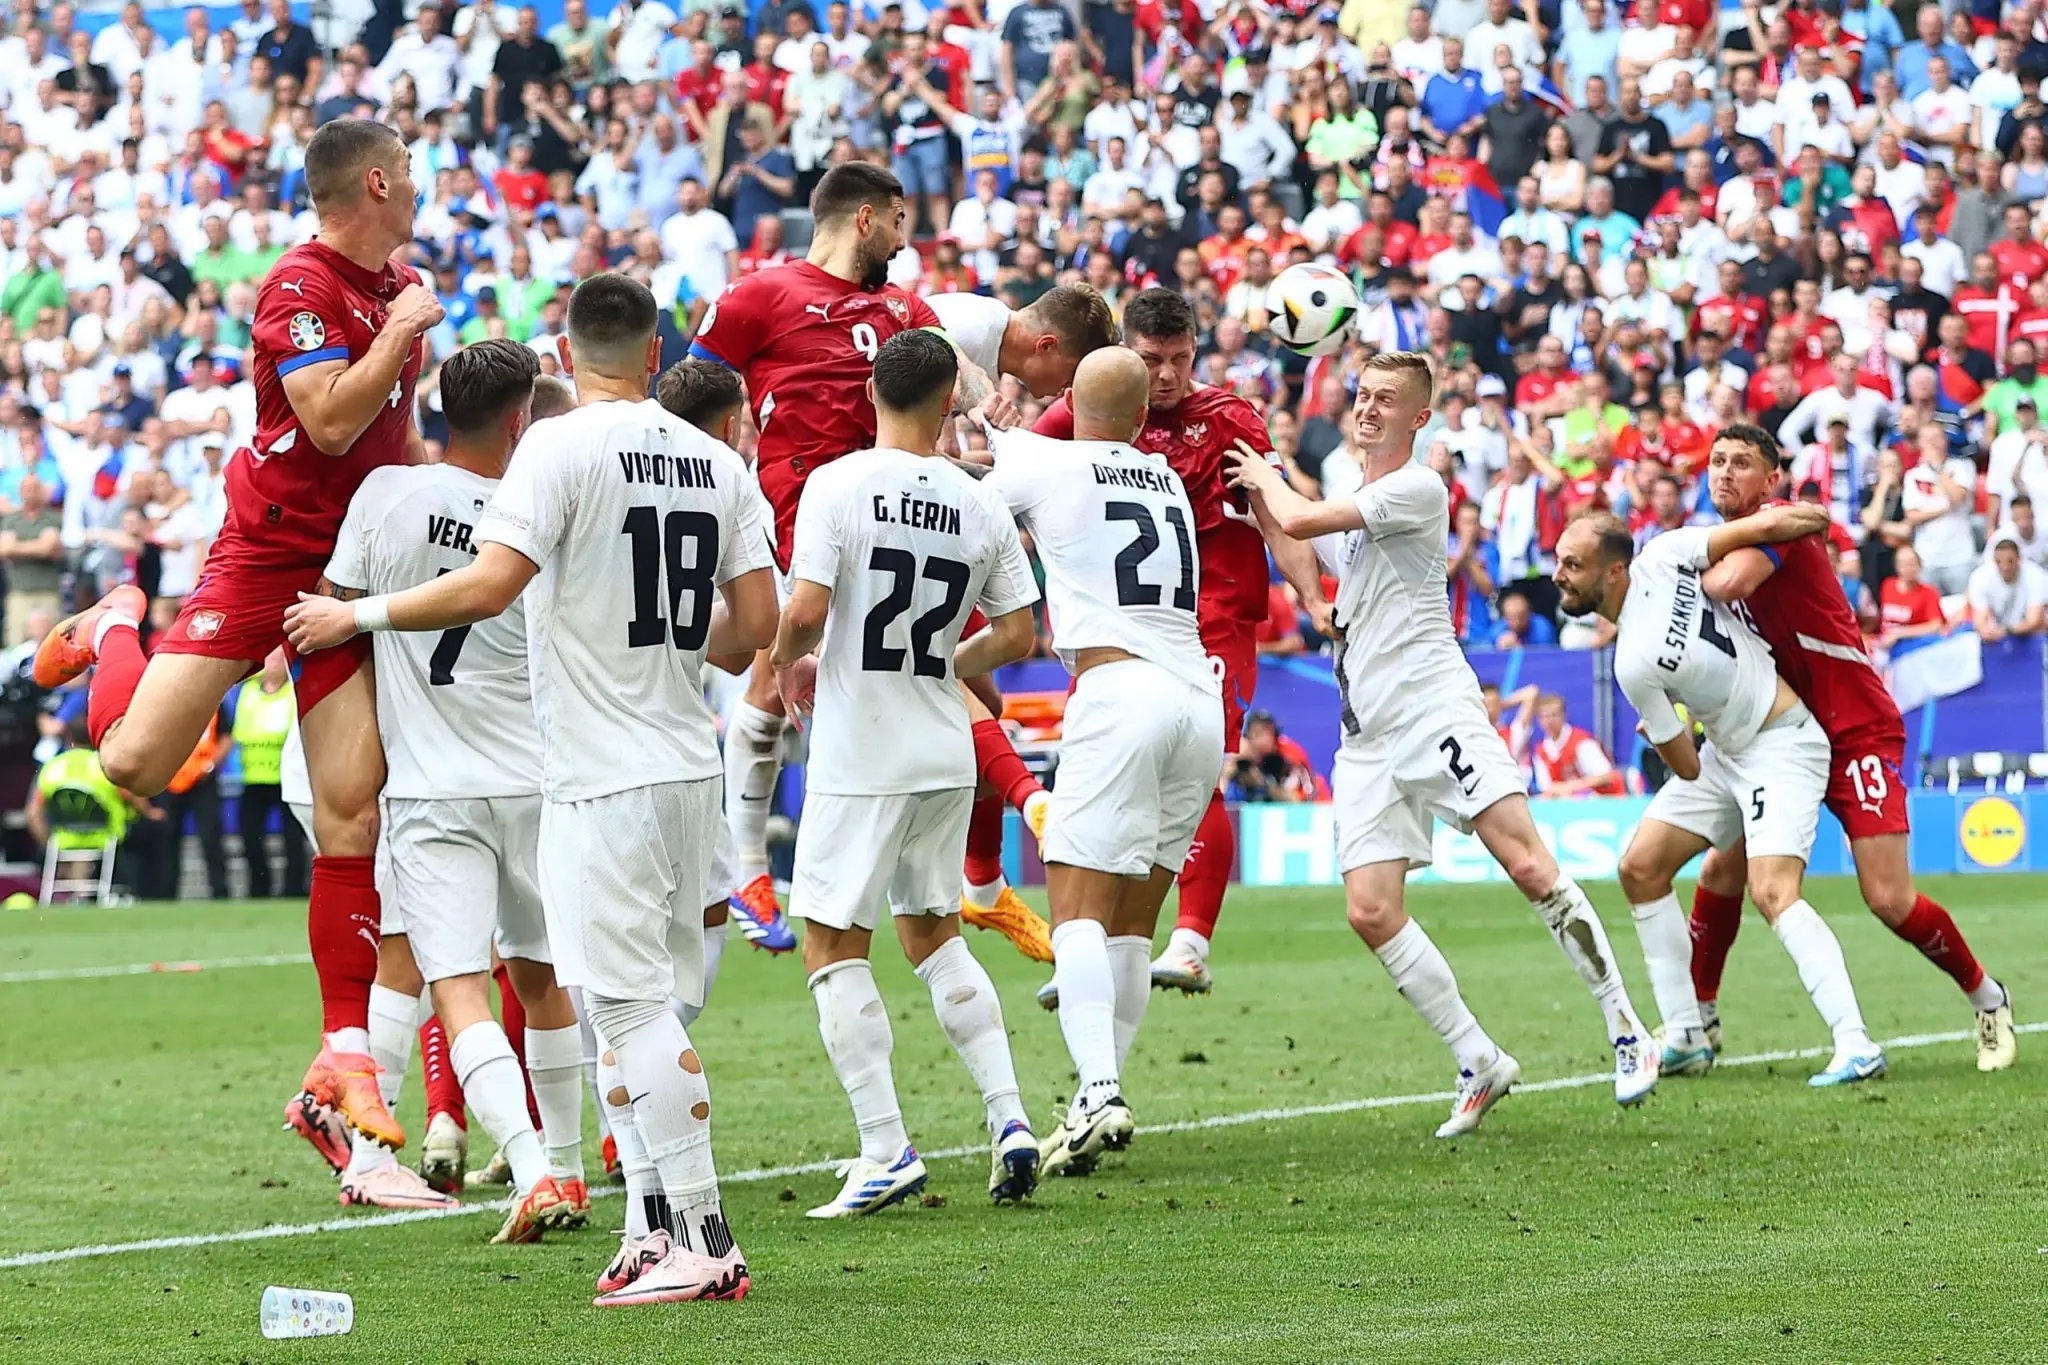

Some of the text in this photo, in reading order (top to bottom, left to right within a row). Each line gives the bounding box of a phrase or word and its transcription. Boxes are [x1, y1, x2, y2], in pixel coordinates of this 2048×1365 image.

[851, 322, 878, 362] 9
[428, 514, 480, 556] VER
[873, 491, 961, 536] G. ČERIN
[621, 505, 719, 651] 18
[1105, 501, 1196, 612] 21
[862, 546, 971, 680] 22
[1439, 735, 1475, 784] 2
[1845, 754, 1888, 803] 13
[1751, 786, 1765, 821] 5
